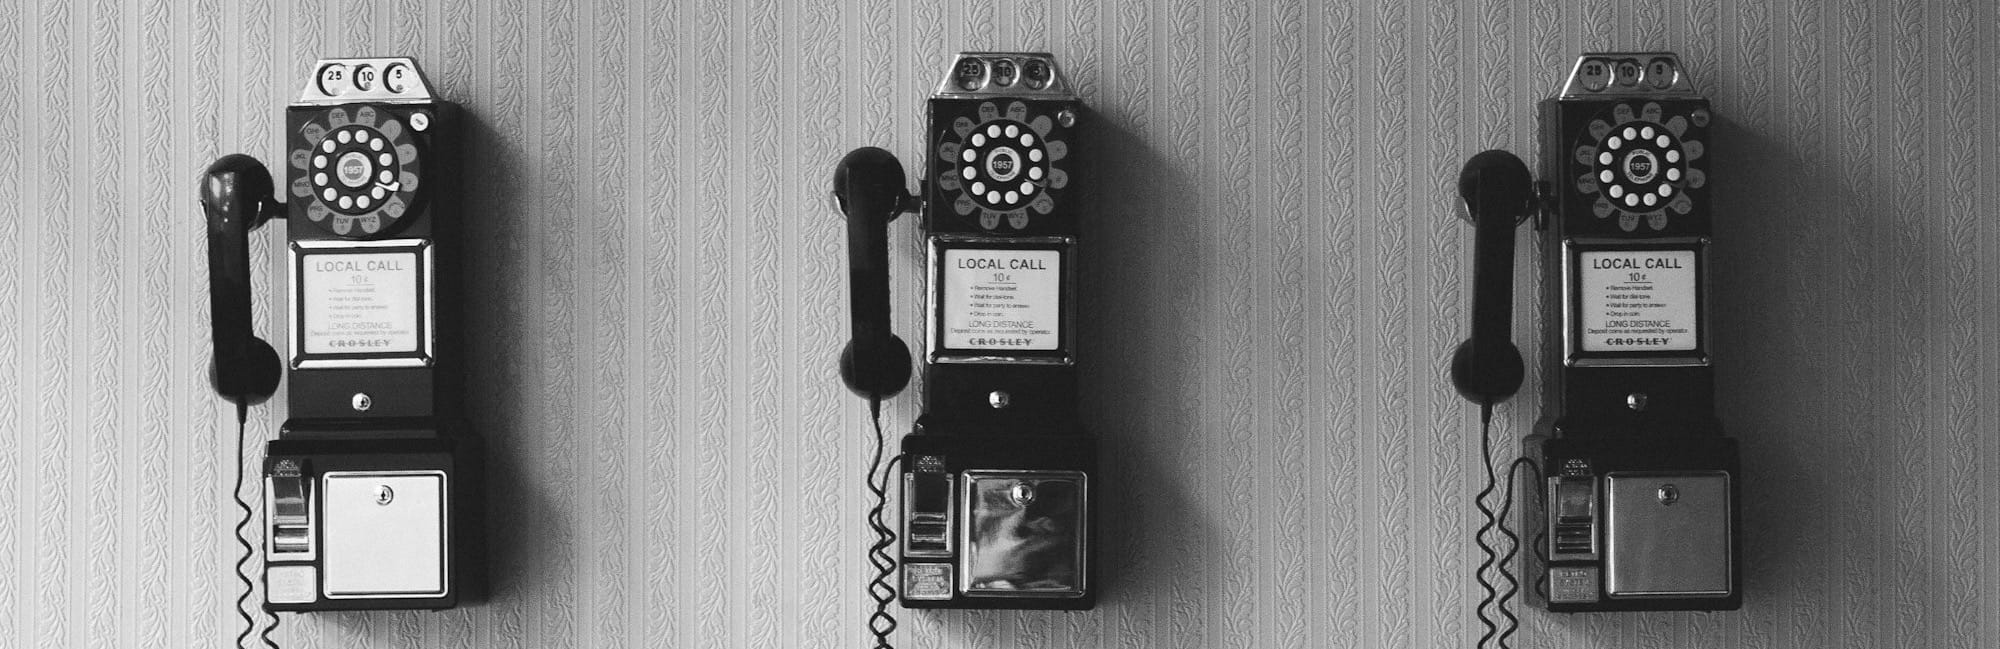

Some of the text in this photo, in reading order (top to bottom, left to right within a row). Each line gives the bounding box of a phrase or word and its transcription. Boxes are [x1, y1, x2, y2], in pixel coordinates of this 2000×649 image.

[999, 66, 1011, 77] 10
[1587, 65, 1601, 75] 25
[1622, 66, 1634, 77] 10
[1656, 64, 1663, 74] 5
[328, 71, 342, 80] 25
[362, 72, 374, 82] 10
[396, 70, 402, 78] 5
[993, 160, 1012, 169] 1957
[317, 260, 403, 272] LOCAL CALL
[959, 258, 1046, 270] LOCAL CALL
[1594, 258, 1682, 269] LOCAL CALL
[328, 321, 392, 330] LONG DISTANCE
[993, 320, 1034, 329] DISTANCE
[1606, 320, 1671, 328] LONG DISTANCE
[969, 338, 1032, 346] CROSLEY
[1606, 338, 1669, 346] CROSLEY
